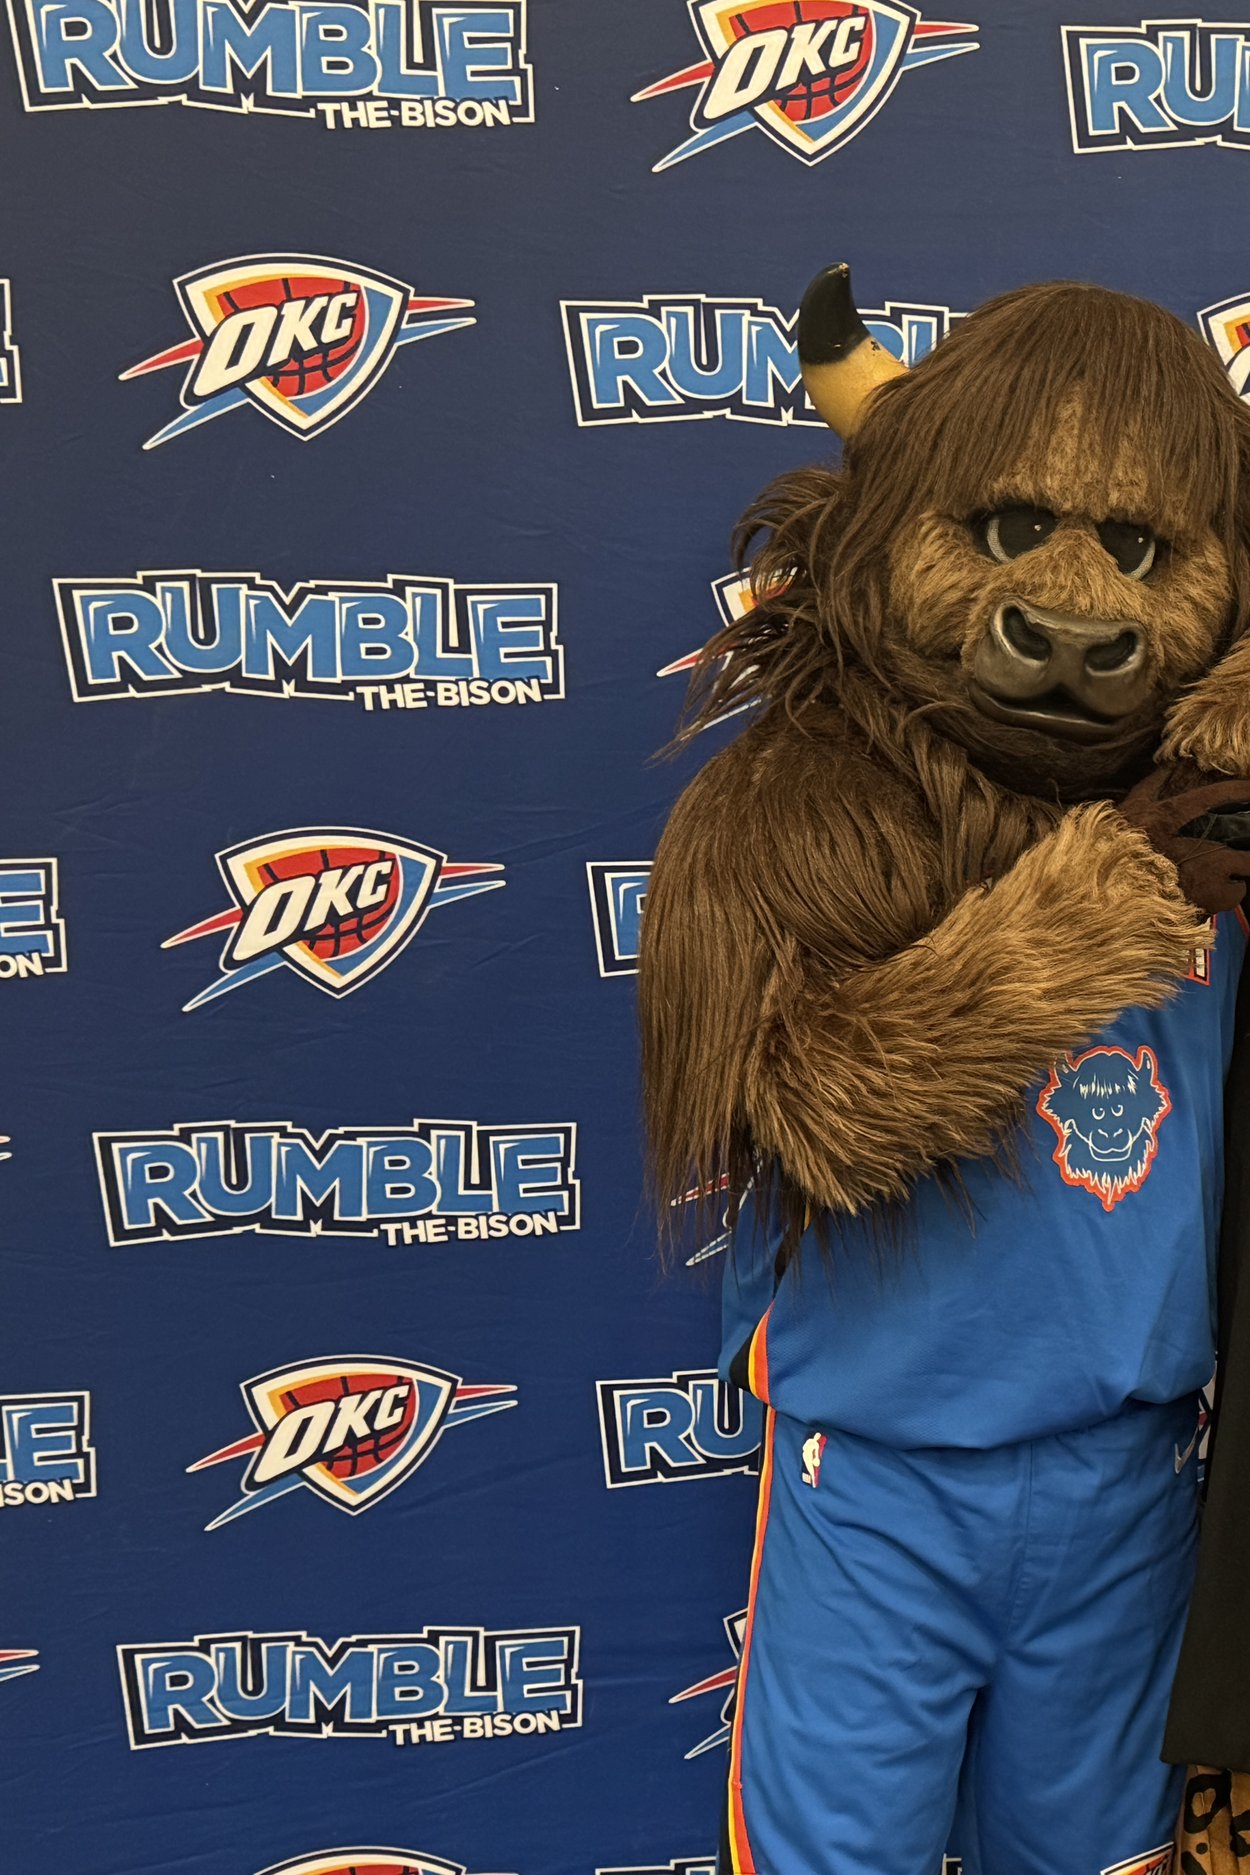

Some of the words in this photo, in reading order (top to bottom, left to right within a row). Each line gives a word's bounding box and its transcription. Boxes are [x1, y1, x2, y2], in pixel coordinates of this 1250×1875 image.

[25, 0, 521, 105] RUMBLE
[703, 17, 866, 120] OKC
[193, 293, 358, 397] OKC
[72, 581, 552, 684] RUMBLE
[233, 861, 393, 961] OKC
[112, 1130, 568, 1229] RUMBLE
[254, 1386, 410, 1483] OKC
[135, 1636, 571, 1734] RUMBLE
